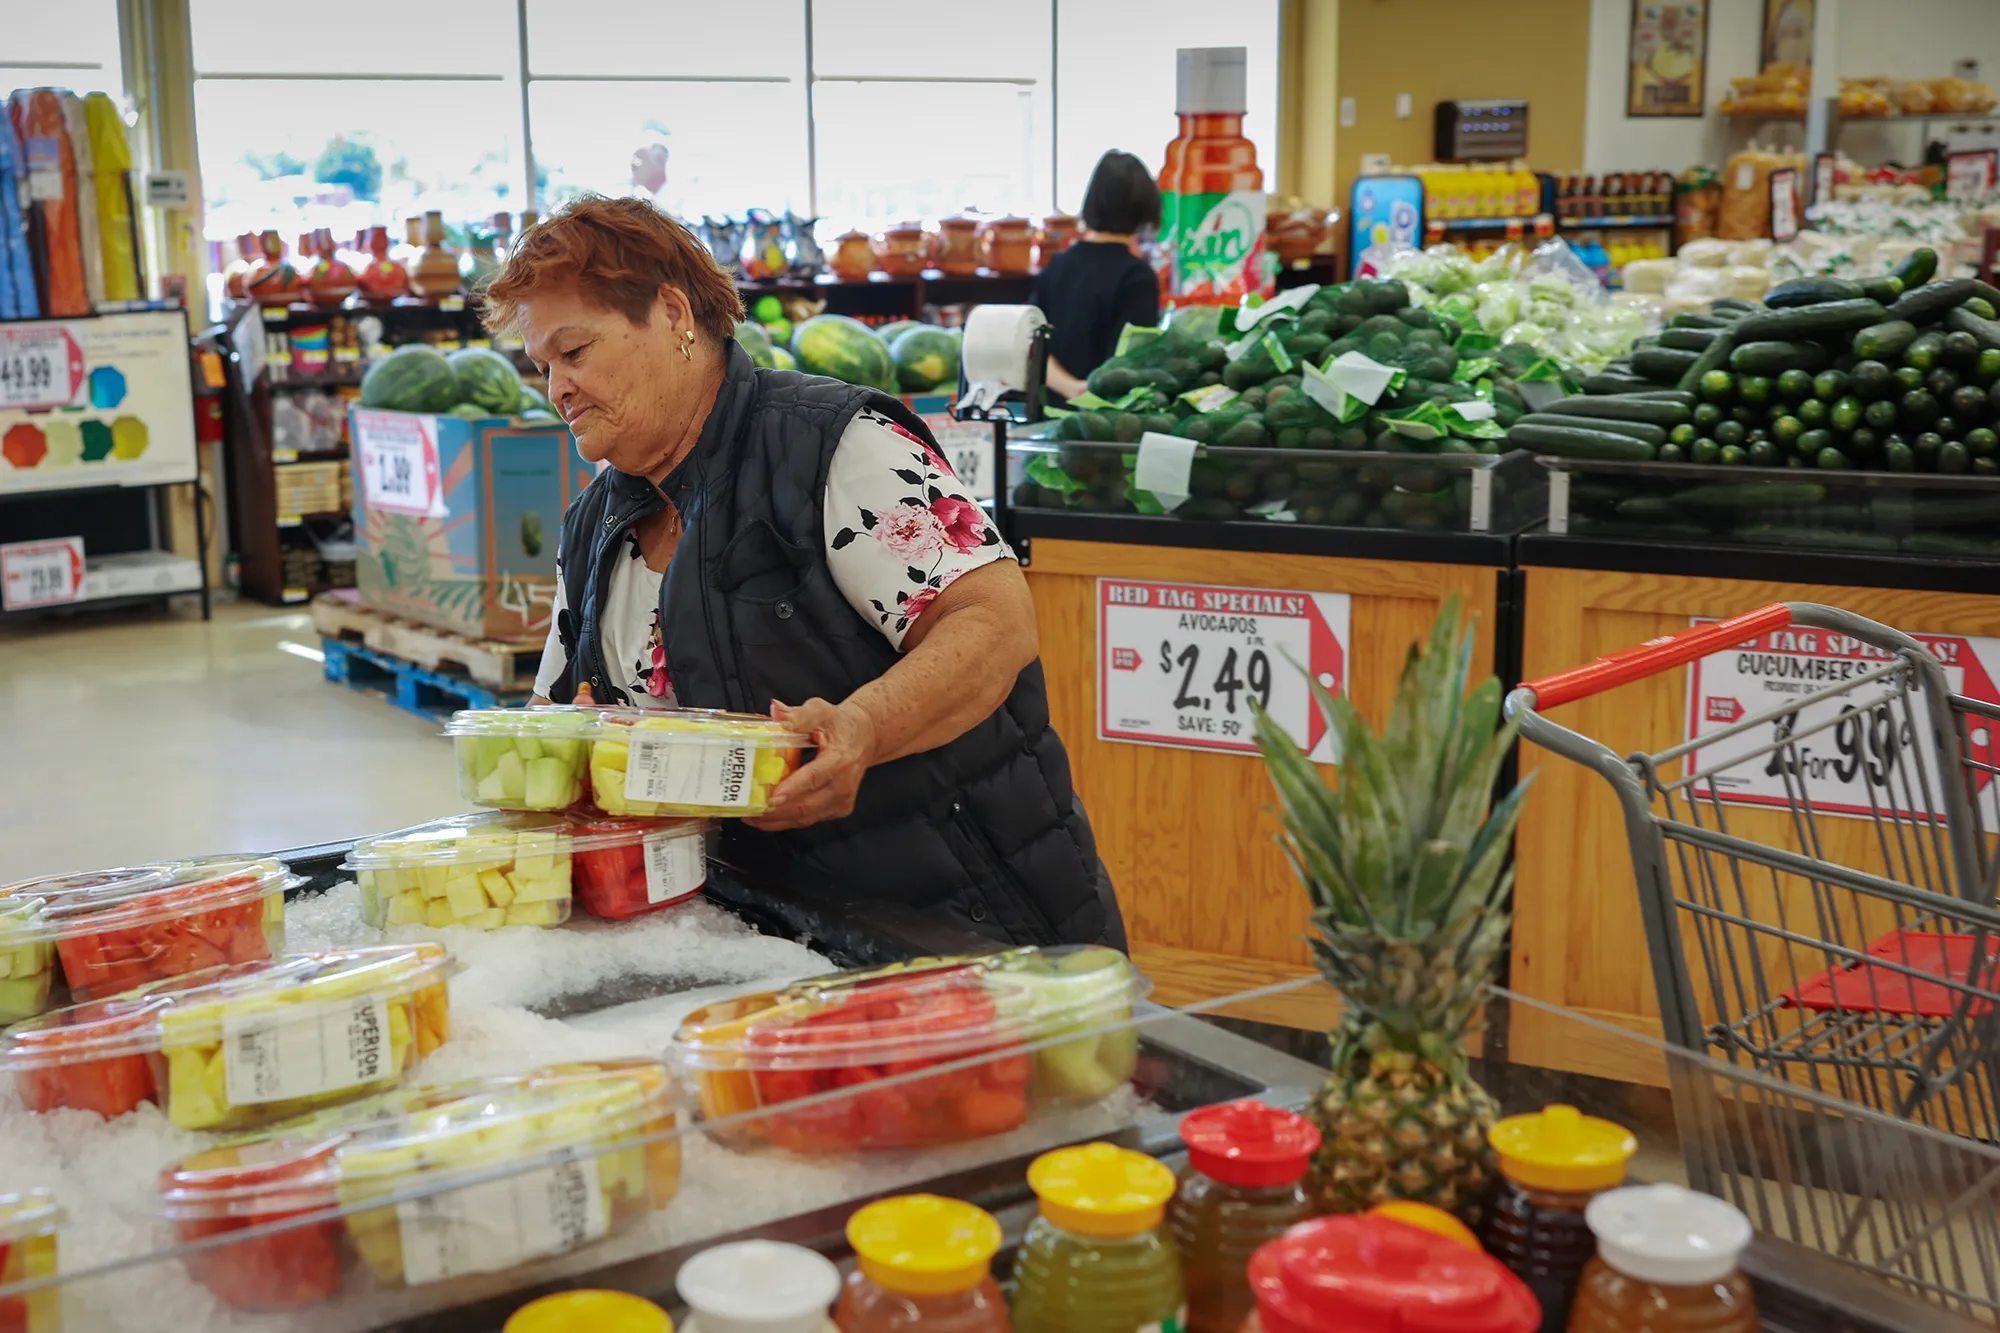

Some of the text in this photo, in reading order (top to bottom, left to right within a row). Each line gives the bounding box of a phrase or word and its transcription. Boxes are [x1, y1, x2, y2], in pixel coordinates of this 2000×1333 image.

[1108, 584, 1306, 616] RED TAG SPECIALS!
[1178, 613, 1258, 634] AVOCADOS
[1769, 630, 1813, 654] TAG
[729, 743, 746, 802] UPERIOR
[360, 1004, 380, 1077] UPERIOR
